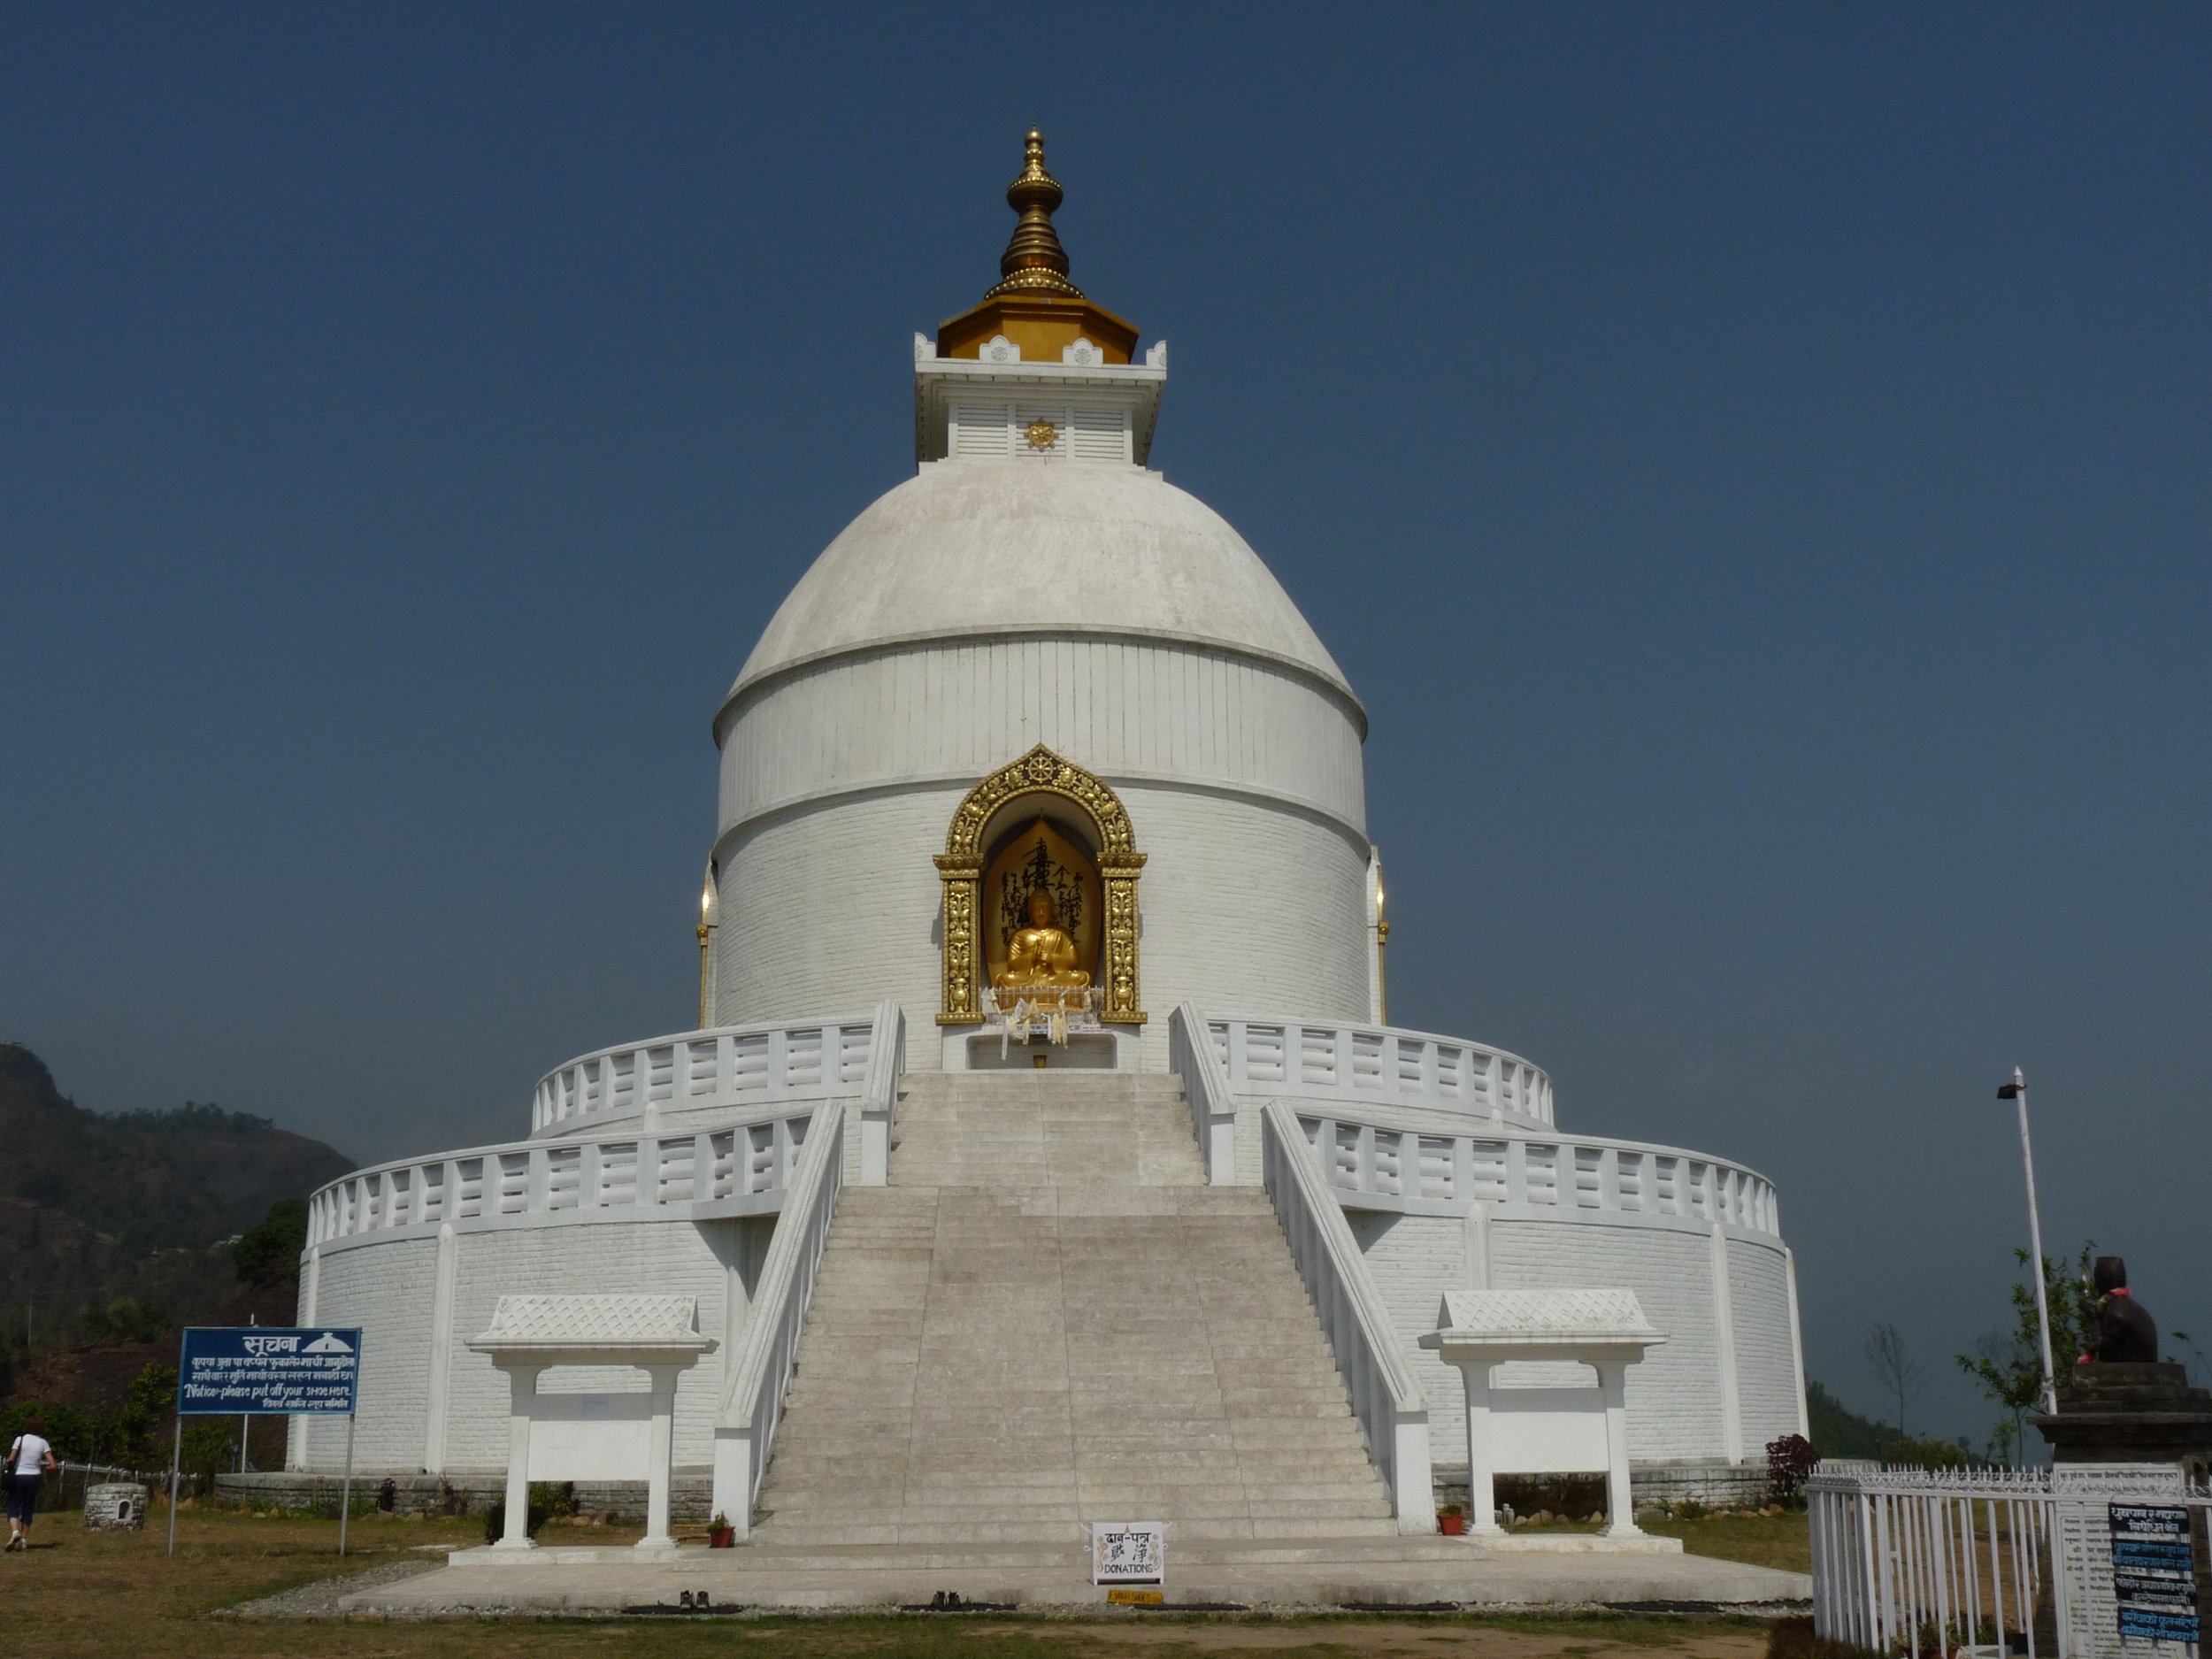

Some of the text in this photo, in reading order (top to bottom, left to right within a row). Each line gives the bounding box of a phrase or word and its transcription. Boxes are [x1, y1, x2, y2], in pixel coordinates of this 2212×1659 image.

[242, 1336, 301, 1356] सूचना
[251, 1383, 269, 1400] put
[270, 1382, 284, 1396] off
[283, 1386, 304, 1400] your
[1104, 1564, 1153, 1573] DONATIONS
